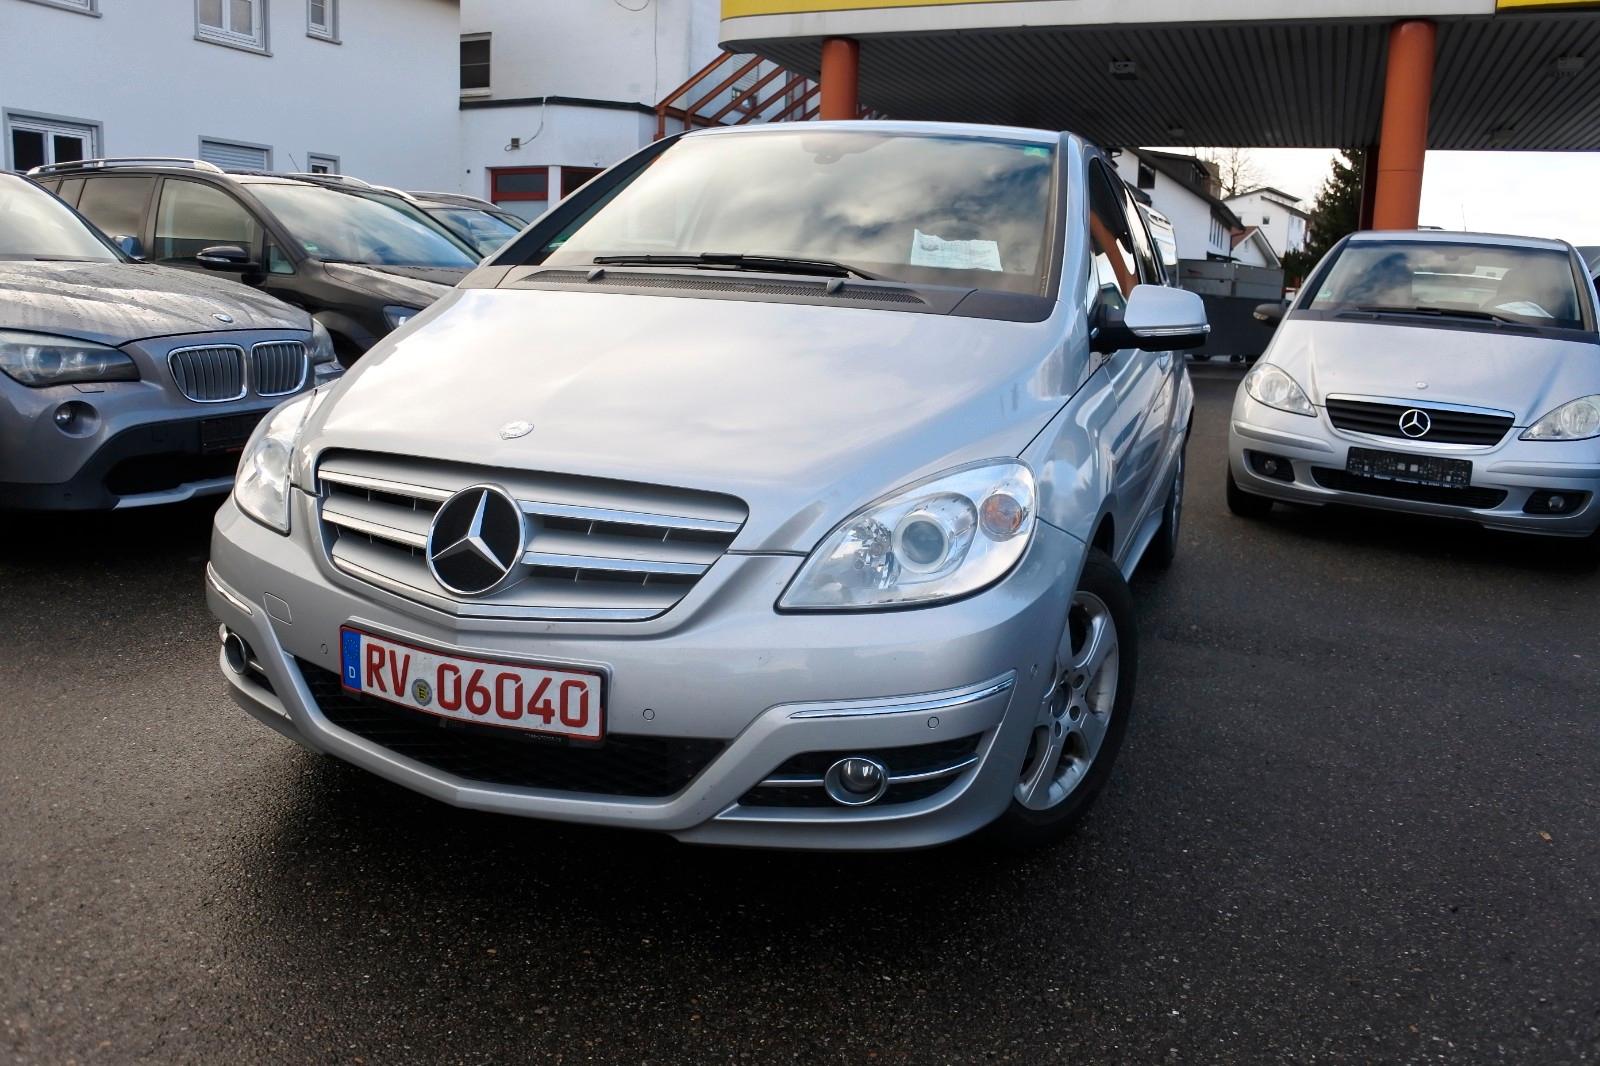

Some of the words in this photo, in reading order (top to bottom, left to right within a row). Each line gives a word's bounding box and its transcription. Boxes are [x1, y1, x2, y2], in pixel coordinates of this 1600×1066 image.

[348, 665, 356, 679] D
[366, 643, 411, 698] RV
[437, 662, 589, 728] 06040
